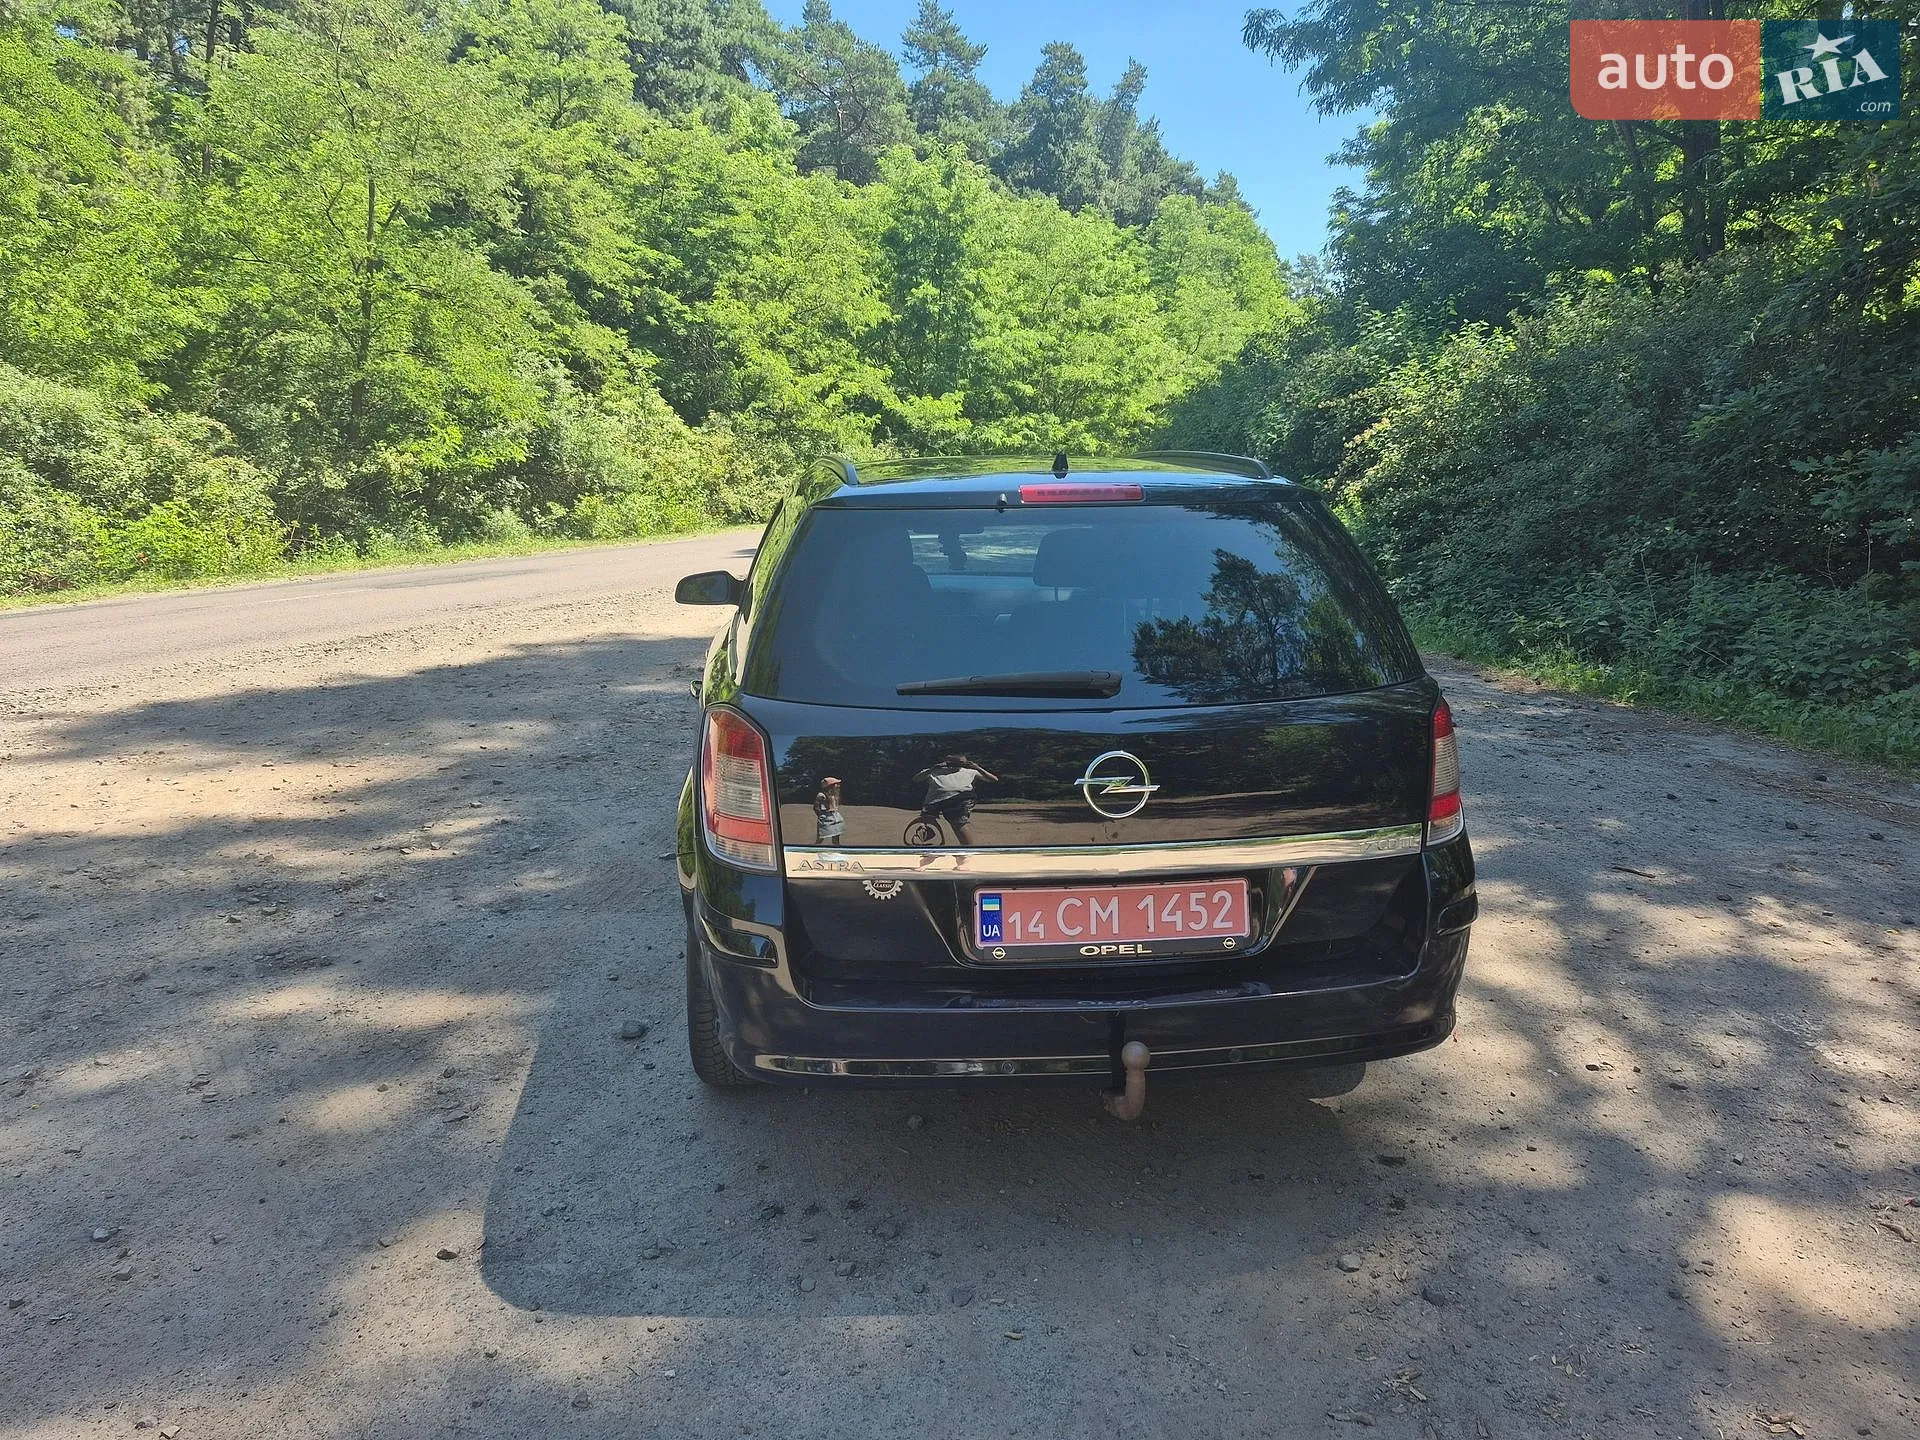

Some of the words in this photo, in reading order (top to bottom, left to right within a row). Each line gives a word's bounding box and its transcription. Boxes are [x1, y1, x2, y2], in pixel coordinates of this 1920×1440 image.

[798, 859, 865, 872] ASTRA
[1008, 911, 1046, 940] 14
[1056, 895, 1119, 937] CM
[1136, 890, 1234, 933] 1452
[982, 923, 1001, 938] UA
[1079, 944, 1152, 956] OPEL
